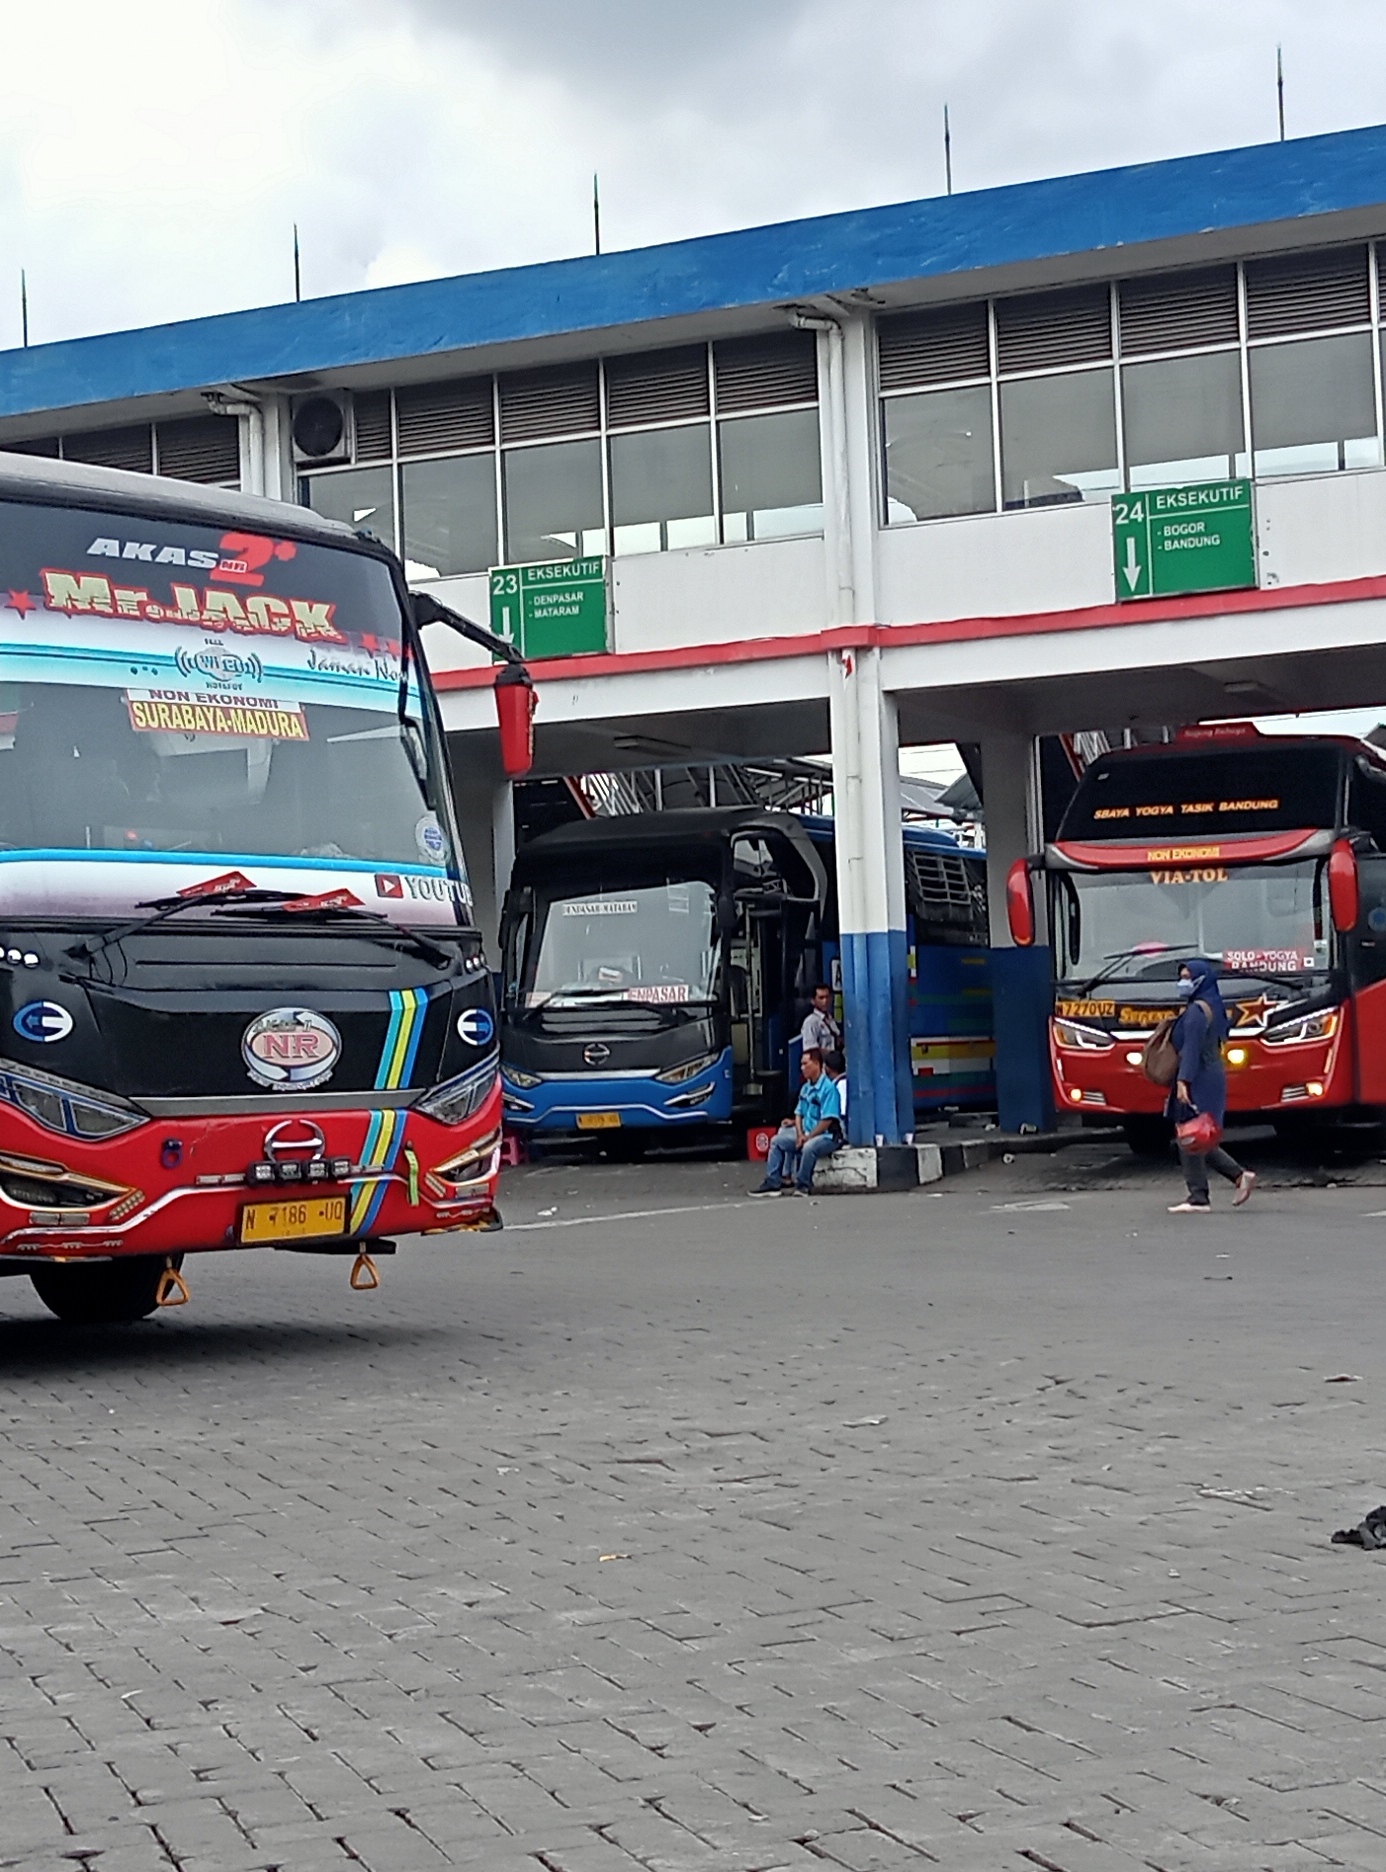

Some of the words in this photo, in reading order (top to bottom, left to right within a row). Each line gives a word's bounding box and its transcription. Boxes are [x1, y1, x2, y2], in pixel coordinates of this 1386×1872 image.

[1156, 486, 1243, 509] EKSEKUTIF
[1115, 501, 1144, 525] 24
[1163, 521, 1206, 537] BOGOR
[87, 537, 219, 569] AKAS
[1164, 534, 1221, 551] BANDUNG
[527, 562, 600, 580] EKSEKUTIF
[493, 574, 518, 595] 23
[534, 592, 584, 606] DENPASAR
[534, 605, 580, 618] MATARAM
[149, 689, 191, 702] NON
[196, 691, 279, 710] EKONOMI
[131, 702, 305, 738] SURABAYA-MADURA
[1093, 807, 1131, 820] SBAYA
[1135, 804, 1175, 817] YOGYA
[1180, 801, 1215, 814] TASIK
[1218, 799, 1280, 812] BANDUNG
[1149, 867, 1229, 885] VIA-TOL
[1227, 950, 1255, 961] SOLO
[1262, 950, 1299, 961] YOGYA
[628, 985, 688, 1004] ENPASAR
[263, 1033, 320, 1059] NR
[246, 1208, 256, 1230] N
